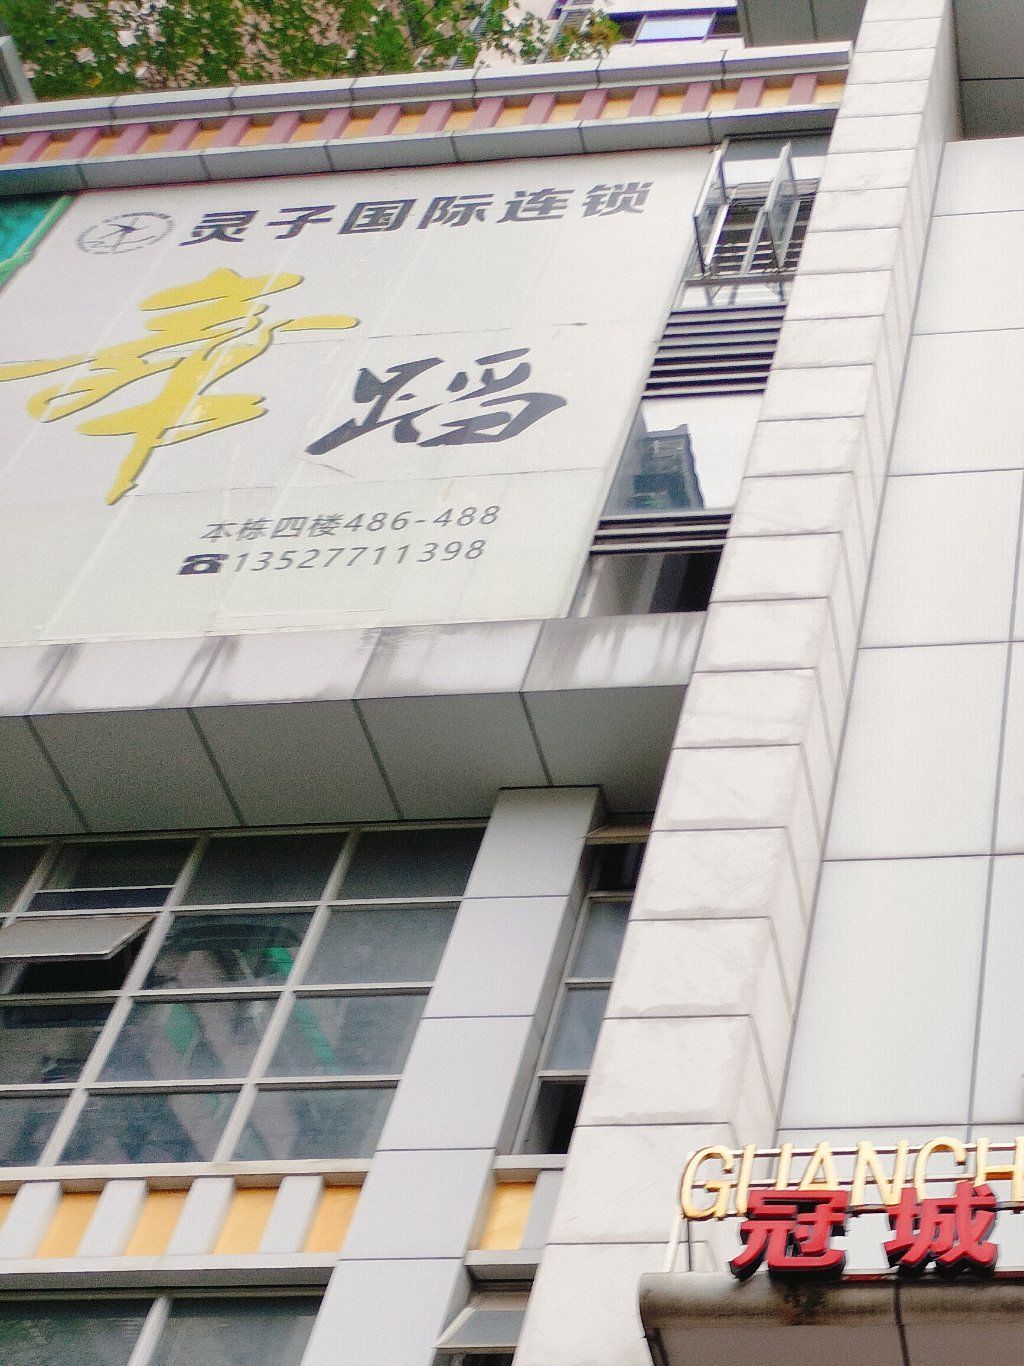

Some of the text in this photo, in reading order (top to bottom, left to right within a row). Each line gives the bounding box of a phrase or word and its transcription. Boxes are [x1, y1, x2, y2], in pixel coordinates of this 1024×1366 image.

[178, 181, 654, 246] 灵子国际连锁
[201, 504, 500, 543] 本栋四楼486-488
[232, 538, 488, 574] 13527711398
